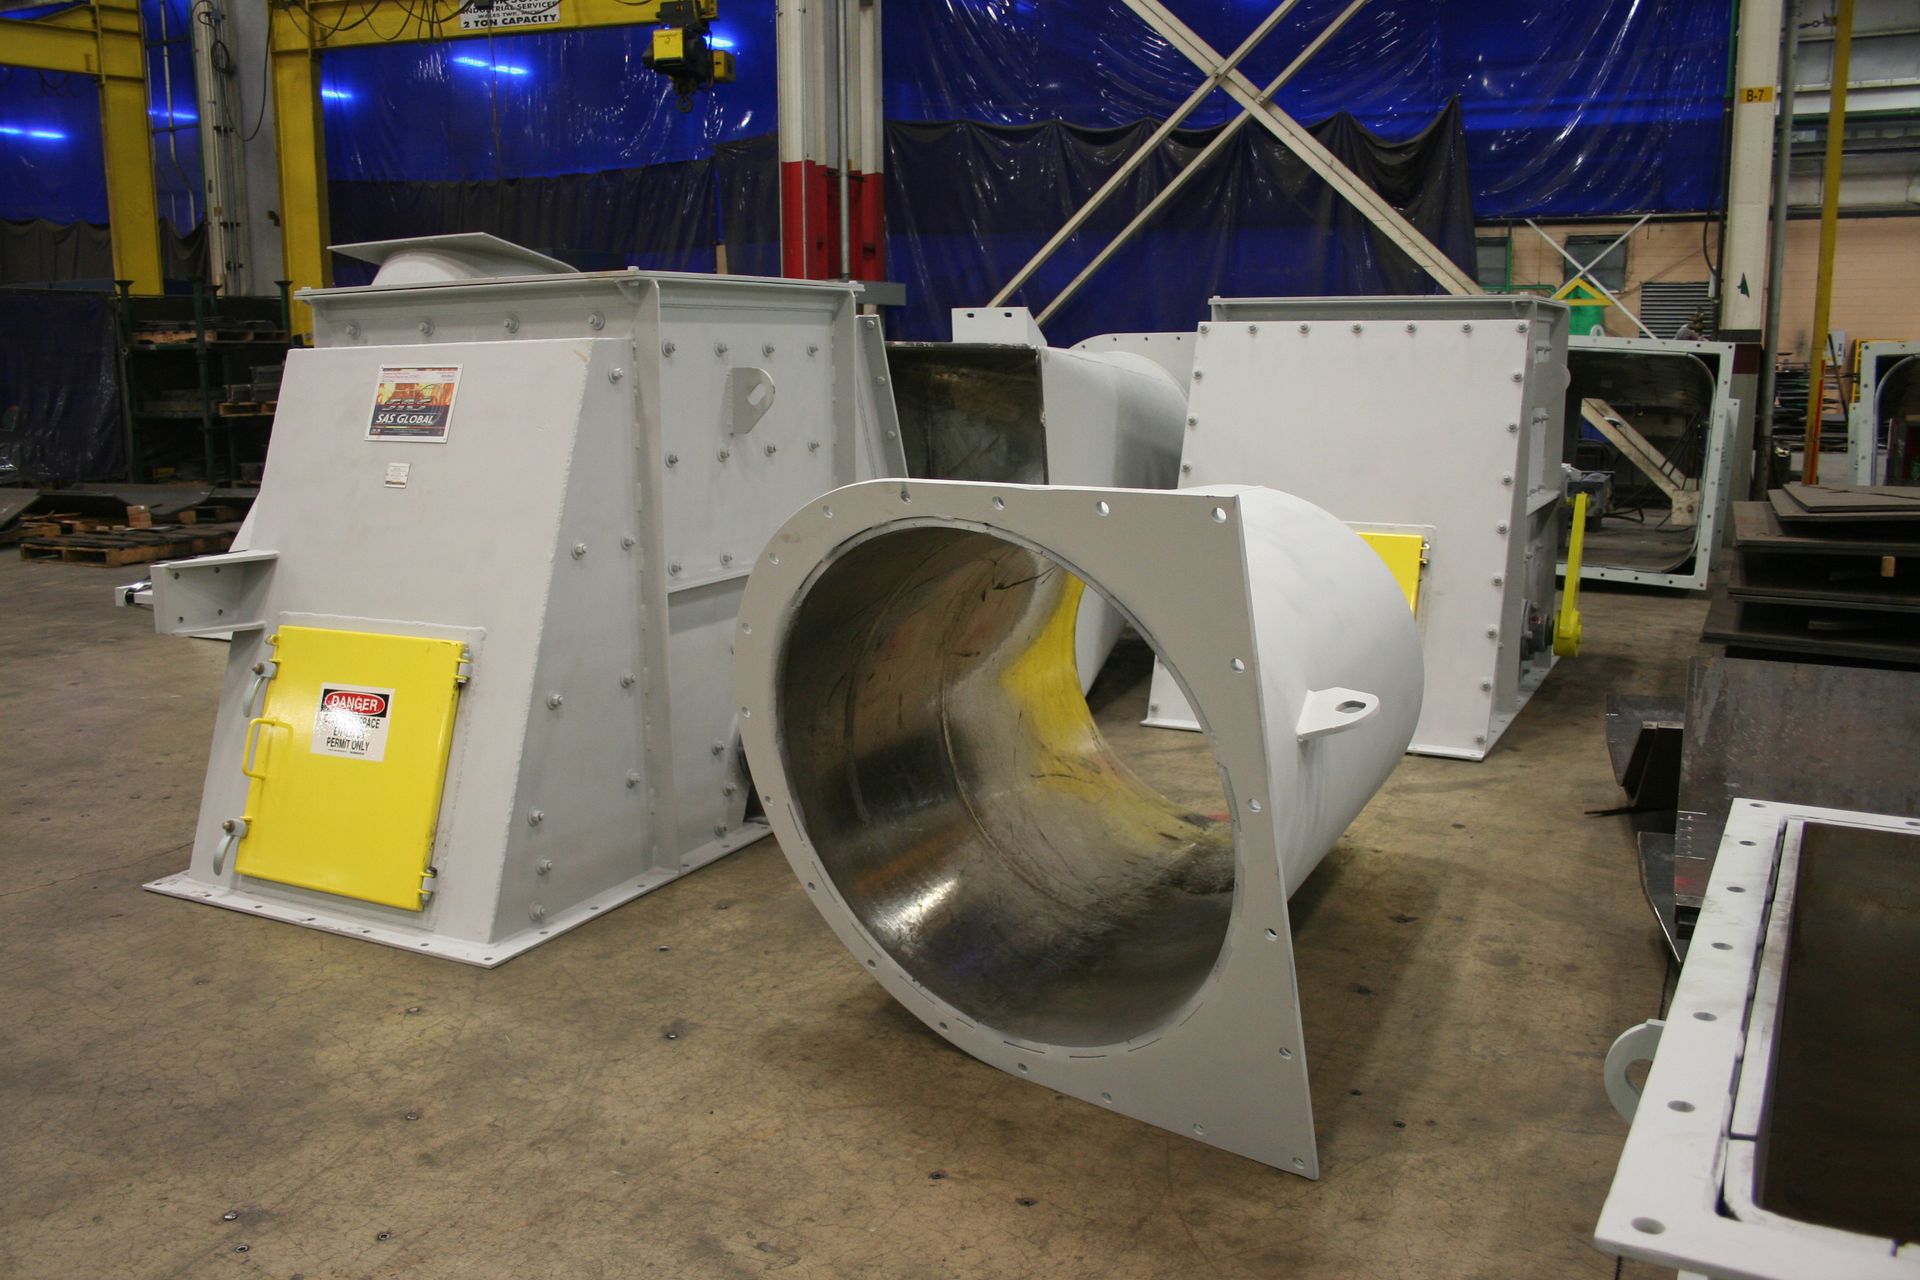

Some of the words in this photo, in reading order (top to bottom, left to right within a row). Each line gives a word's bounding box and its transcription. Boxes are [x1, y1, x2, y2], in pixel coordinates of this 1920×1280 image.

[474, 19, 497, 27] TON
[502, 14, 557, 25] CAPACITY
[1747, 89, 1764, 102] B-7
[376, 413, 396, 423] SAS
[396, 414, 434, 424] GLOBAL
[331, 695, 378, 711] DANGER
[359, 717, 380, 729] PACE
[327, 737, 350, 748] PERMIT
[351, 740, 370, 752] ONLY
